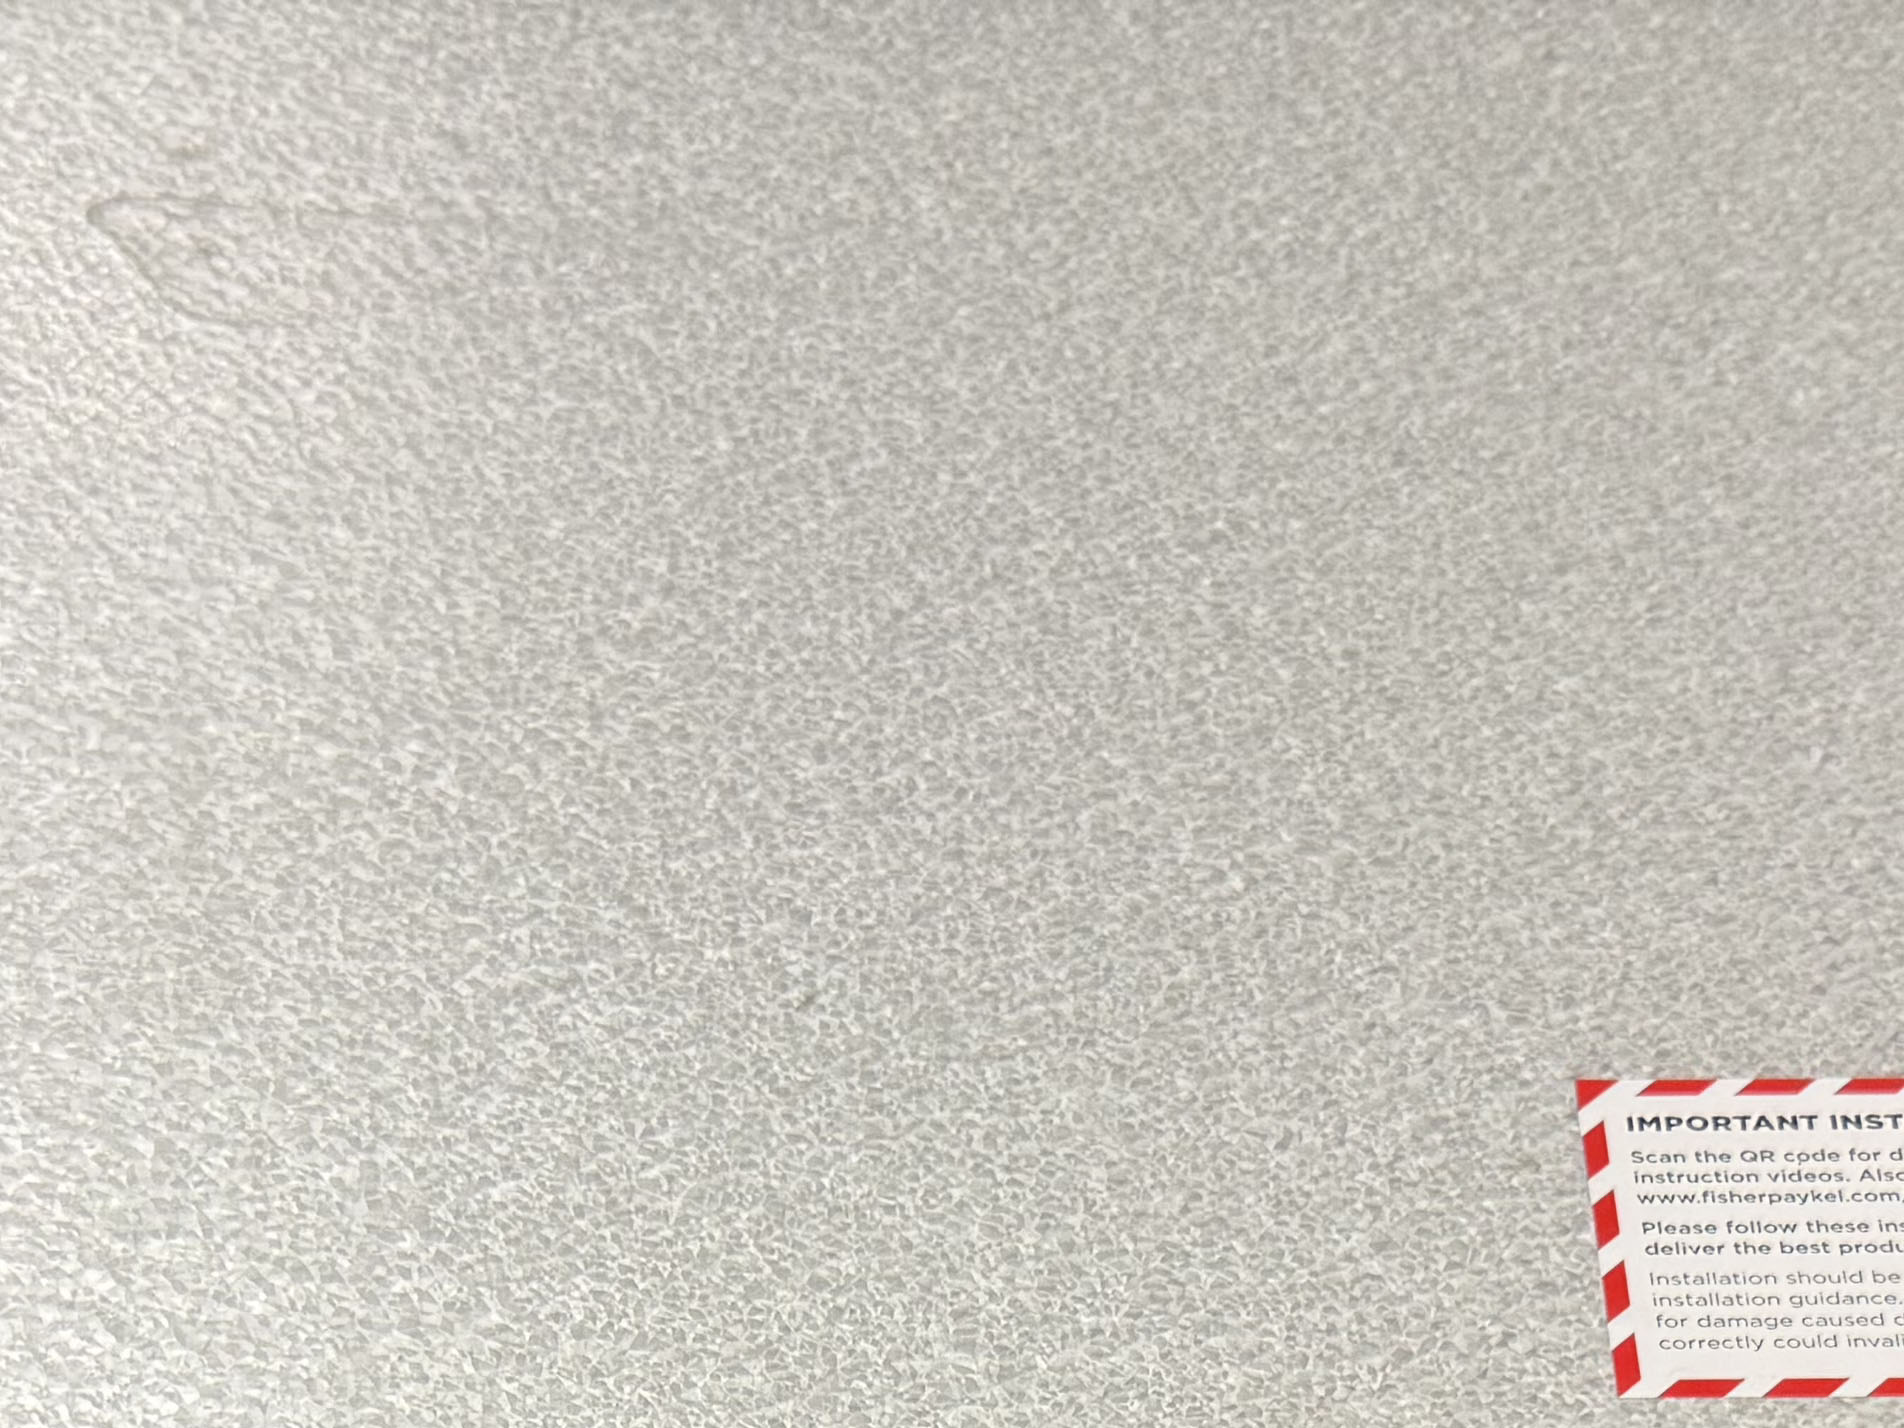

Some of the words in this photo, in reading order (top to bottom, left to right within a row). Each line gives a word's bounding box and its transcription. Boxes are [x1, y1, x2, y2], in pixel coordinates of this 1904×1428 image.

[1626, 1114, 1818, 1132] IMPORTANT
[1631, 1150, 1686, 1164] Scan
[1695, 1149, 1732, 1163] the
[1740, 1150, 1775, 1163] QR
[1784, 1149, 1840, 1162] code
[1849, 1148, 1881, 1162] for
[1634, 1170, 1759, 1184] instruction
[1767, 1169, 1851, 1183] videos.
[1641, 1222, 1717, 1235] Please
[1726, 1221, 1797, 1234] follow
[1806, 1220, 1870, 1234] these
[1645, 1242, 1724, 1256] deliver
[1733, 1241, 1771, 1255] the
[1779, 1241, 1831, 1255] best
[1649, 1271, 1777, 1286] Installation
[1786, 1270, 1863, 1285] should
[1871, 1270, 1901, 1284] be
[1652, 1293, 1780, 1307] installation
[1788, 1291, 1903, 1309] guidance.
[1656, 1314, 1688, 1329] for
[1697, 1314, 1793, 1331] damage
[1801, 1313, 1884, 1328] caused
[1658, 1334, 1764, 1351] correctly
[1773, 1334, 1838, 1349] could
